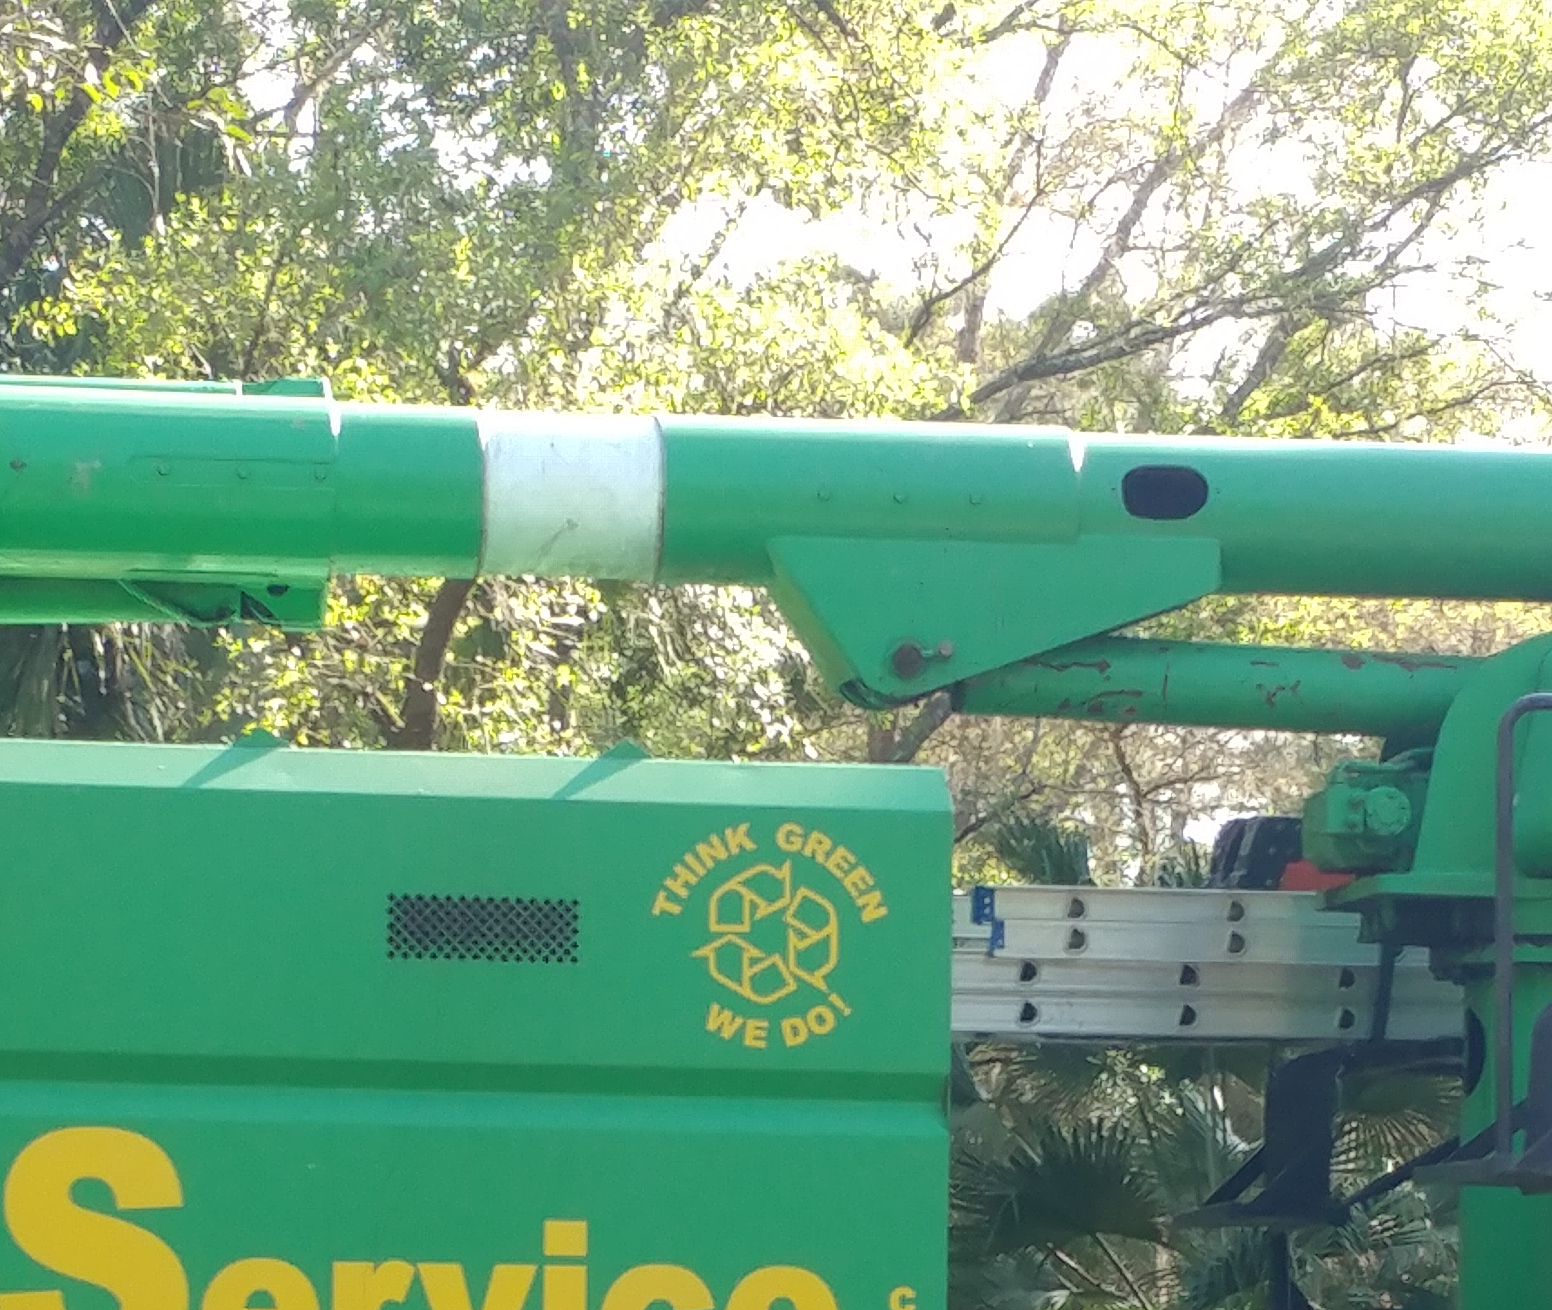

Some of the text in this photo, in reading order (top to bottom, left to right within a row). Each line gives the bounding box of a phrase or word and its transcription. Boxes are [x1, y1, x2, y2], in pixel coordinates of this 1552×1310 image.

[652, 822, 888, 923] THINK GREEN
[705, 992, 852, 1049] WE DO!
